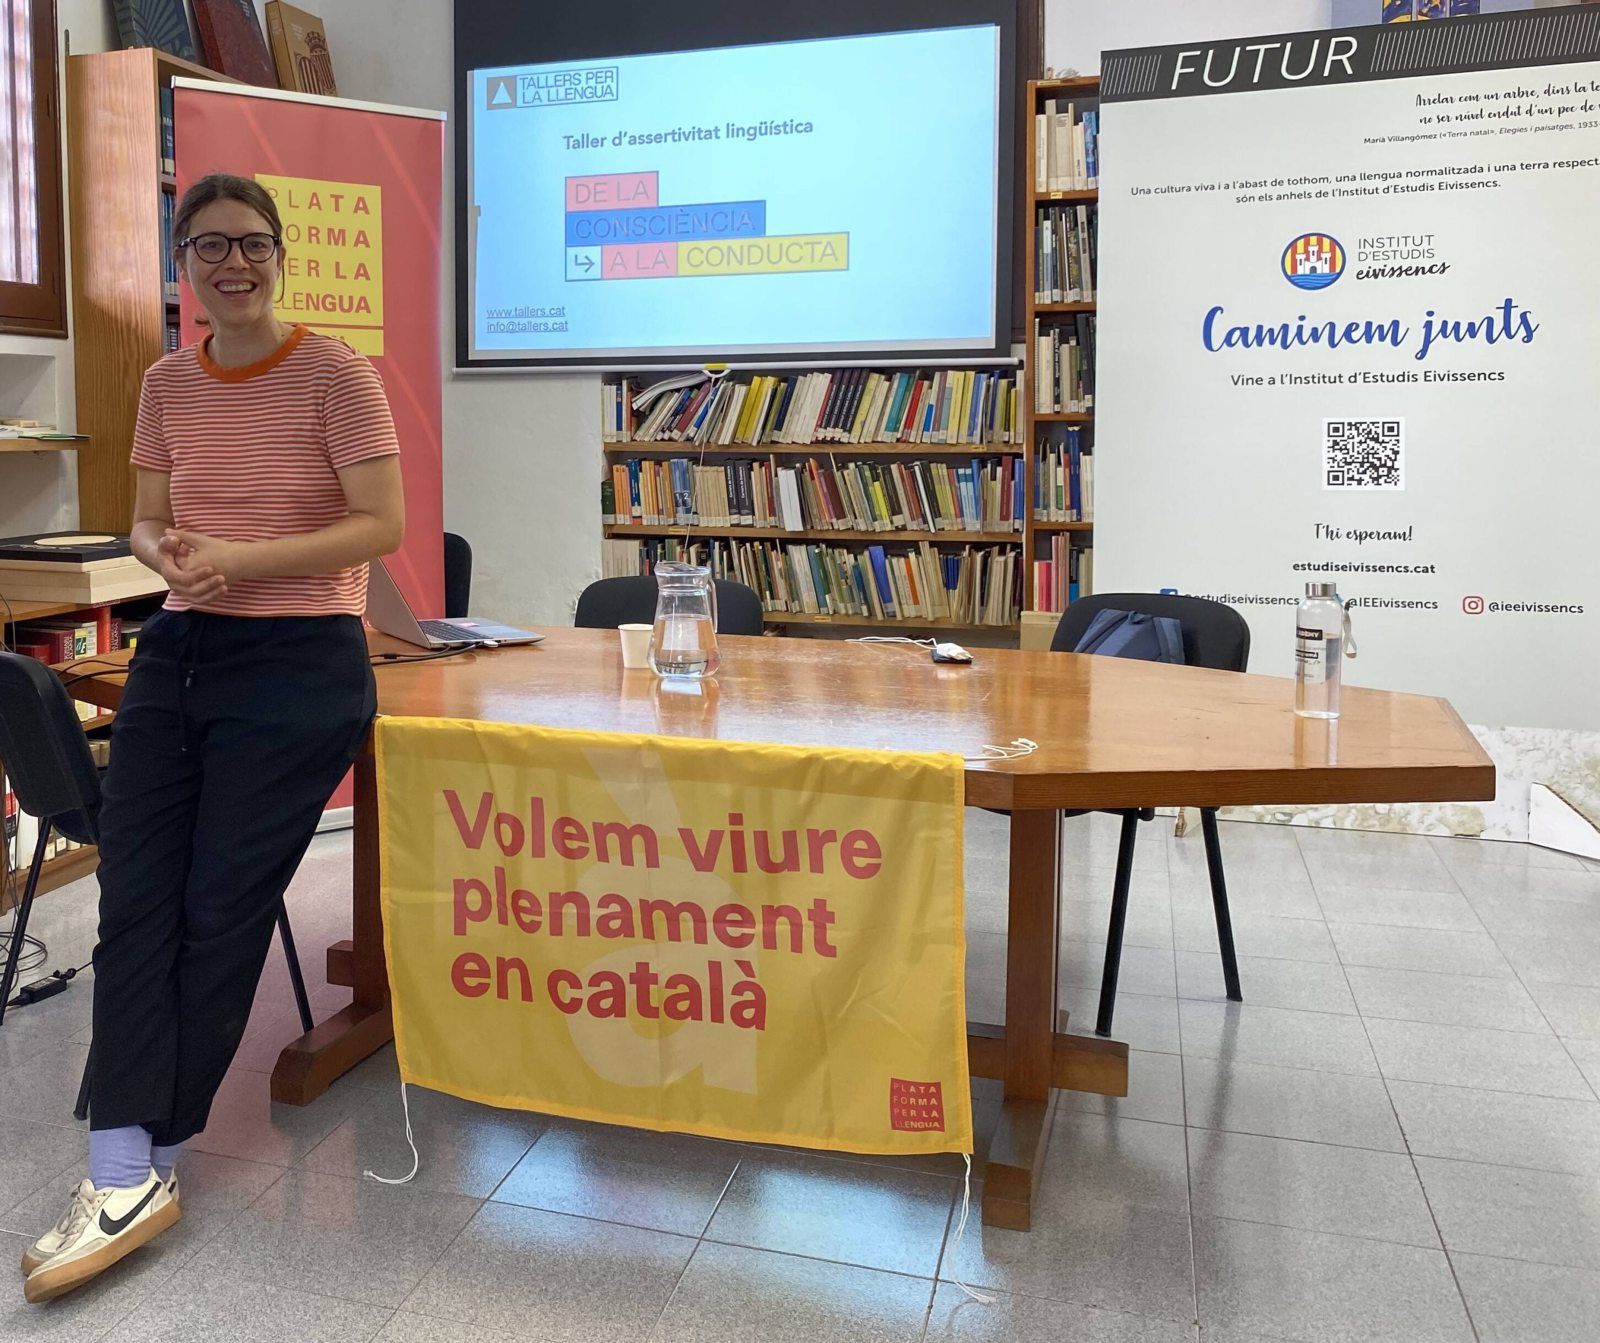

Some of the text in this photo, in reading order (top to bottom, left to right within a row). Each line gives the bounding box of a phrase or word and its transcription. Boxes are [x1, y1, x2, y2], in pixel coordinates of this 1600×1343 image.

[1170, 36, 1359, 90] FUTUR
[519, 70, 614, 90] TALLERS PER
[522, 84, 615, 104] LA LLENGUA
[1415, 93, 1455, 107] Arrelar
[1458, 94, 1480, 103] com
[1483, 93, 1500, 101] un
[1503, 87, 1540, 99] arbre,
[1544, 83, 1571, 96] dins
[1574, 82, 1588, 93] la
[1419, 115, 1433, 124] no
[1436, 112, 1452, 124] ser
[1487, 104, 1523, 119] endut
[1557, 105, 1577, 117] poc
[1580, 99, 1596, 113] de
[563, 133, 606, 150] Taller
[725, 119, 814, 142] lingüística
[1387, 132, 1438, 144] Villangómez
[1578, 120, 1600, 129] 1933
[1130, 187, 1152, 196] Una
[1154, 184, 1192, 195] cultura
[1194, 182, 1216, 192] viva
[1217, 182, 1221, 191] i
[1270, 178, 1285, 188] de
[1287, 175, 1333, 187] tothom,
[1335, 174, 1357, 183] una
[1359, 170, 1402, 183] llengua
[1405, 165, 1484, 179] normalitzada
[1487, 164, 1491, 173] i
[1494, 163, 1517, 172] una
[1519, 161, 1549, 171] terra
[1552, 157, 1600, 170] respect
[575, 180, 650, 205] DE LA
[1235, 194, 1256, 204] són
[1258, 192, 1273, 202] els
[1275, 191, 1313, 201] anhels
[1315, 189, 1329, 199] de
[1438, 179, 1501, 191] Eivissencs.
[575, 206, 756, 240] CONSCIÈNCIA
[286, 224, 371, 248] ORMA
[1357, 234, 1435, 250] INSTITUT
[609, 241, 839, 271] A LA CONDUCTA
[288, 258, 371, 281] ER LA
[1356, 259, 1451, 282] eivissencs
[486, 306, 566, 318] www.tallers.cat
[487, 320, 569, 333] info@tallers.cat
[1202, 298, 1541, 360] Caminem junts
[1230, 374, 1264, 386] Vine
[1267, 376, 1276, 385] a
[1423, 369, 1505, 383] Eivissencs
[1345, 525, 1414, 545] esperam!
[1292, 562, 1437, 575] estudiseivissencs.cat
[1488, 601, 1584, 615] @ieeivissencs
[442, 788, 882, 881] Volem viure
[452, 866, 838, 958] plenament
[450, 950, 767, 1031] en català
[893, 1082, 937, 1094] PLATA
[893, 1095, 938, 1106] FORMA
[893, 1107, 940, 1118] PER LA
[894, 1120, 940, 1129] LLENGUA
